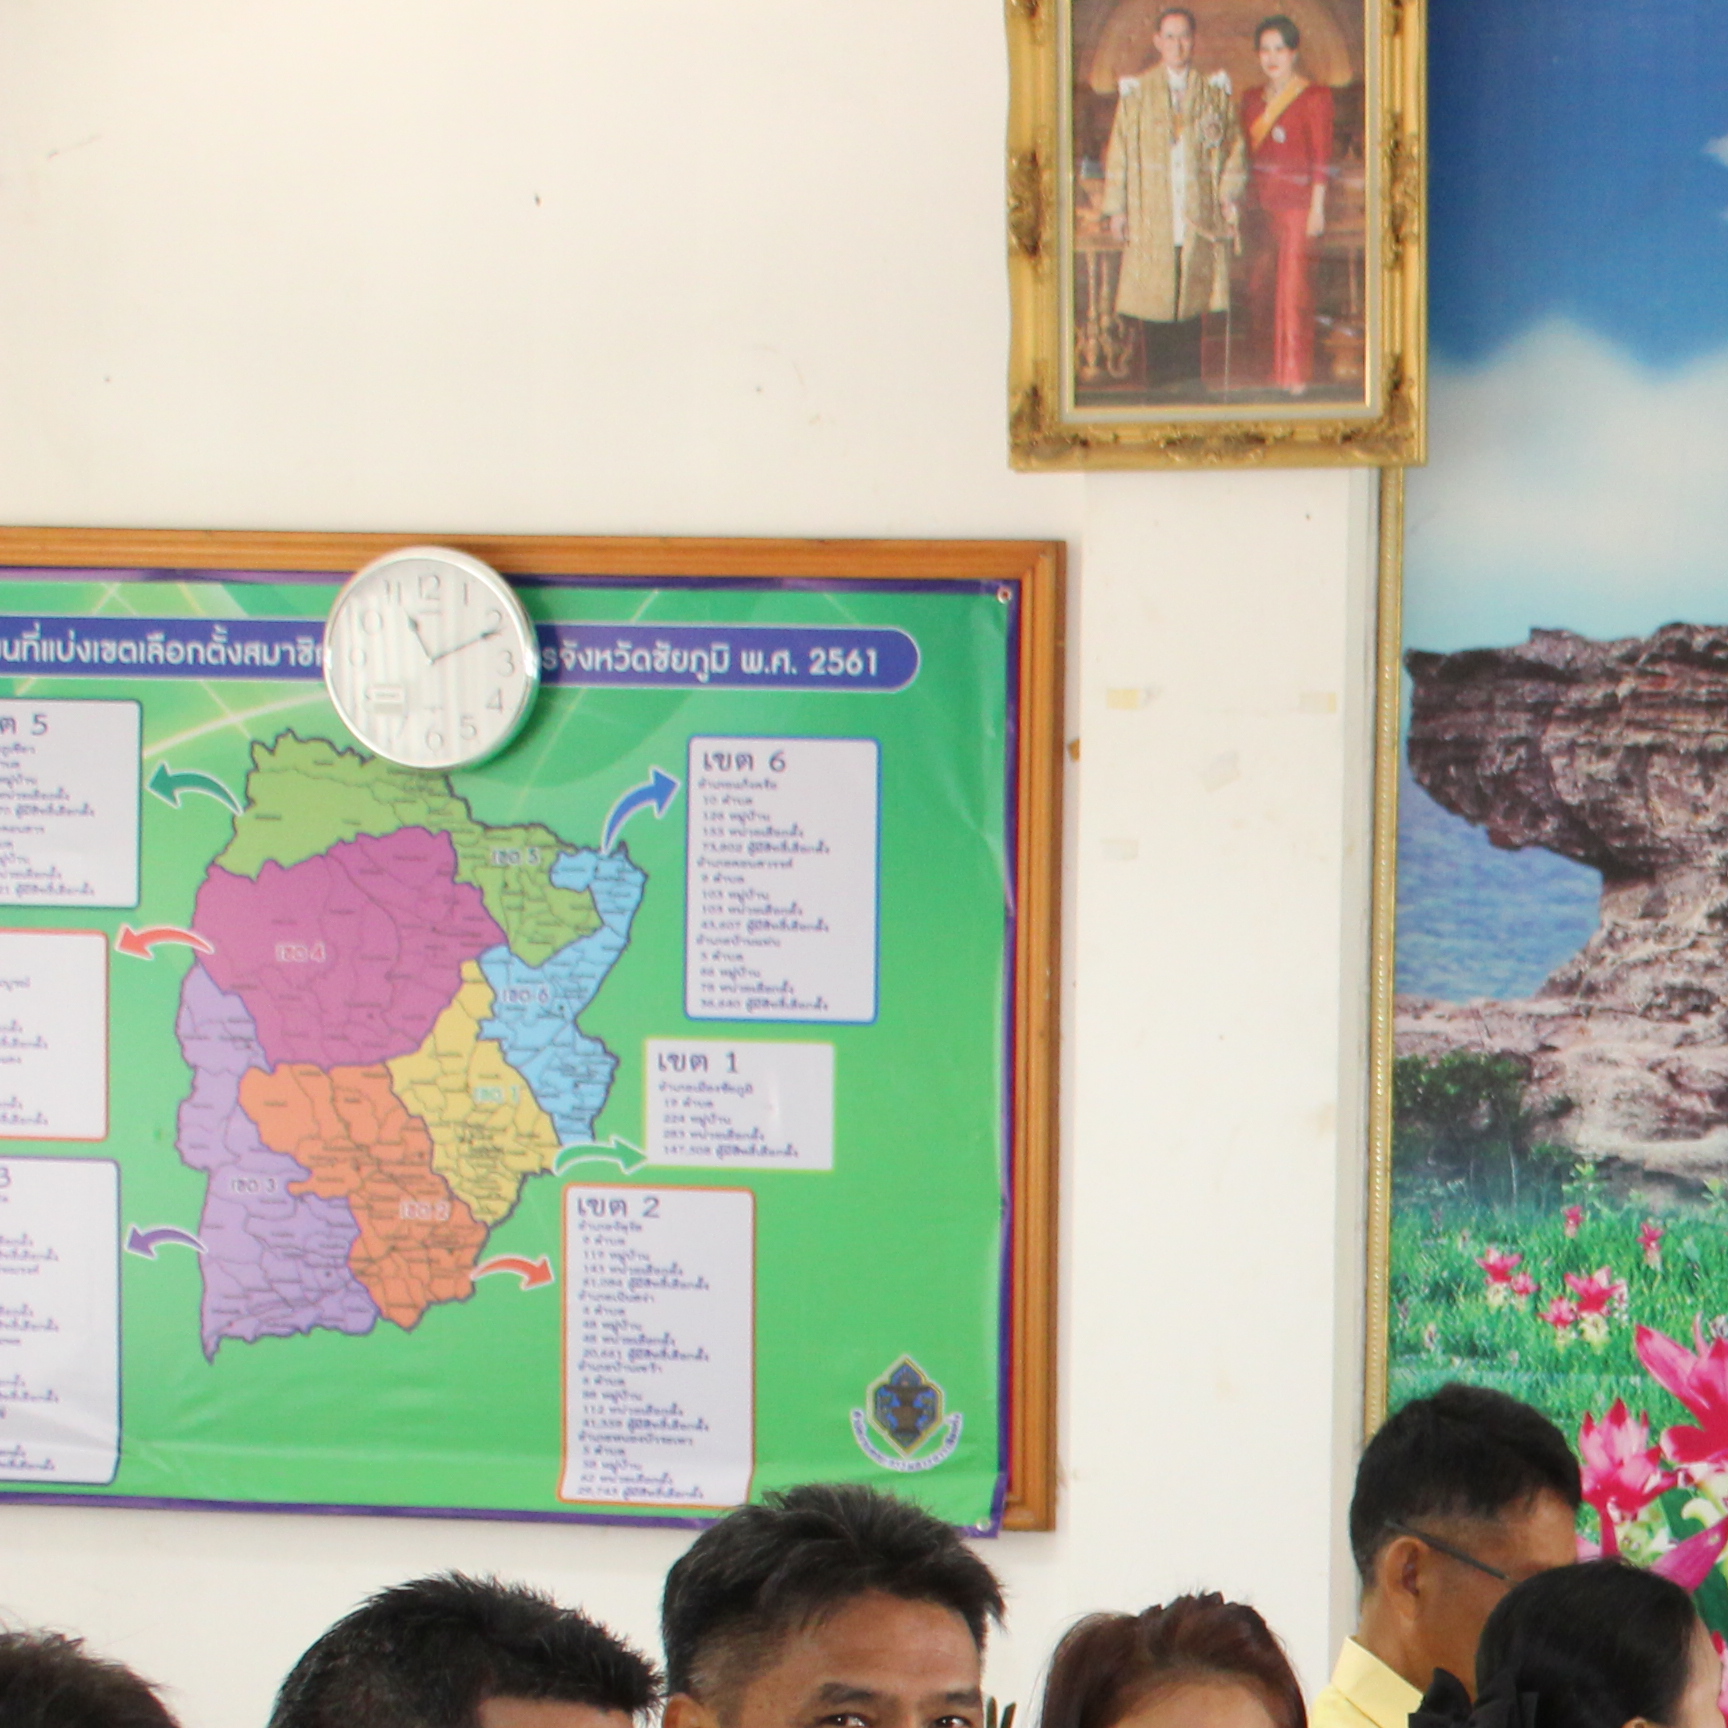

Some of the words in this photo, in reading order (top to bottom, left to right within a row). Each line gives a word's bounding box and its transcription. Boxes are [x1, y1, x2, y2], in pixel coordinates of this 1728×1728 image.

[740, 648, 798, 676] พ.ศ.
[809, 647, 878, 677] 2561
[31, 713, 48, 735] 5
[704, 752, 754, 771] เขต
[769, 750, 786, 772] 6
[658, 1053, 708, 1072] เขต
[726, 1051, 738, 1073] 1
[577, 1197, 627, 1217] เขต
[642, 1196, 660, 1218] 2
